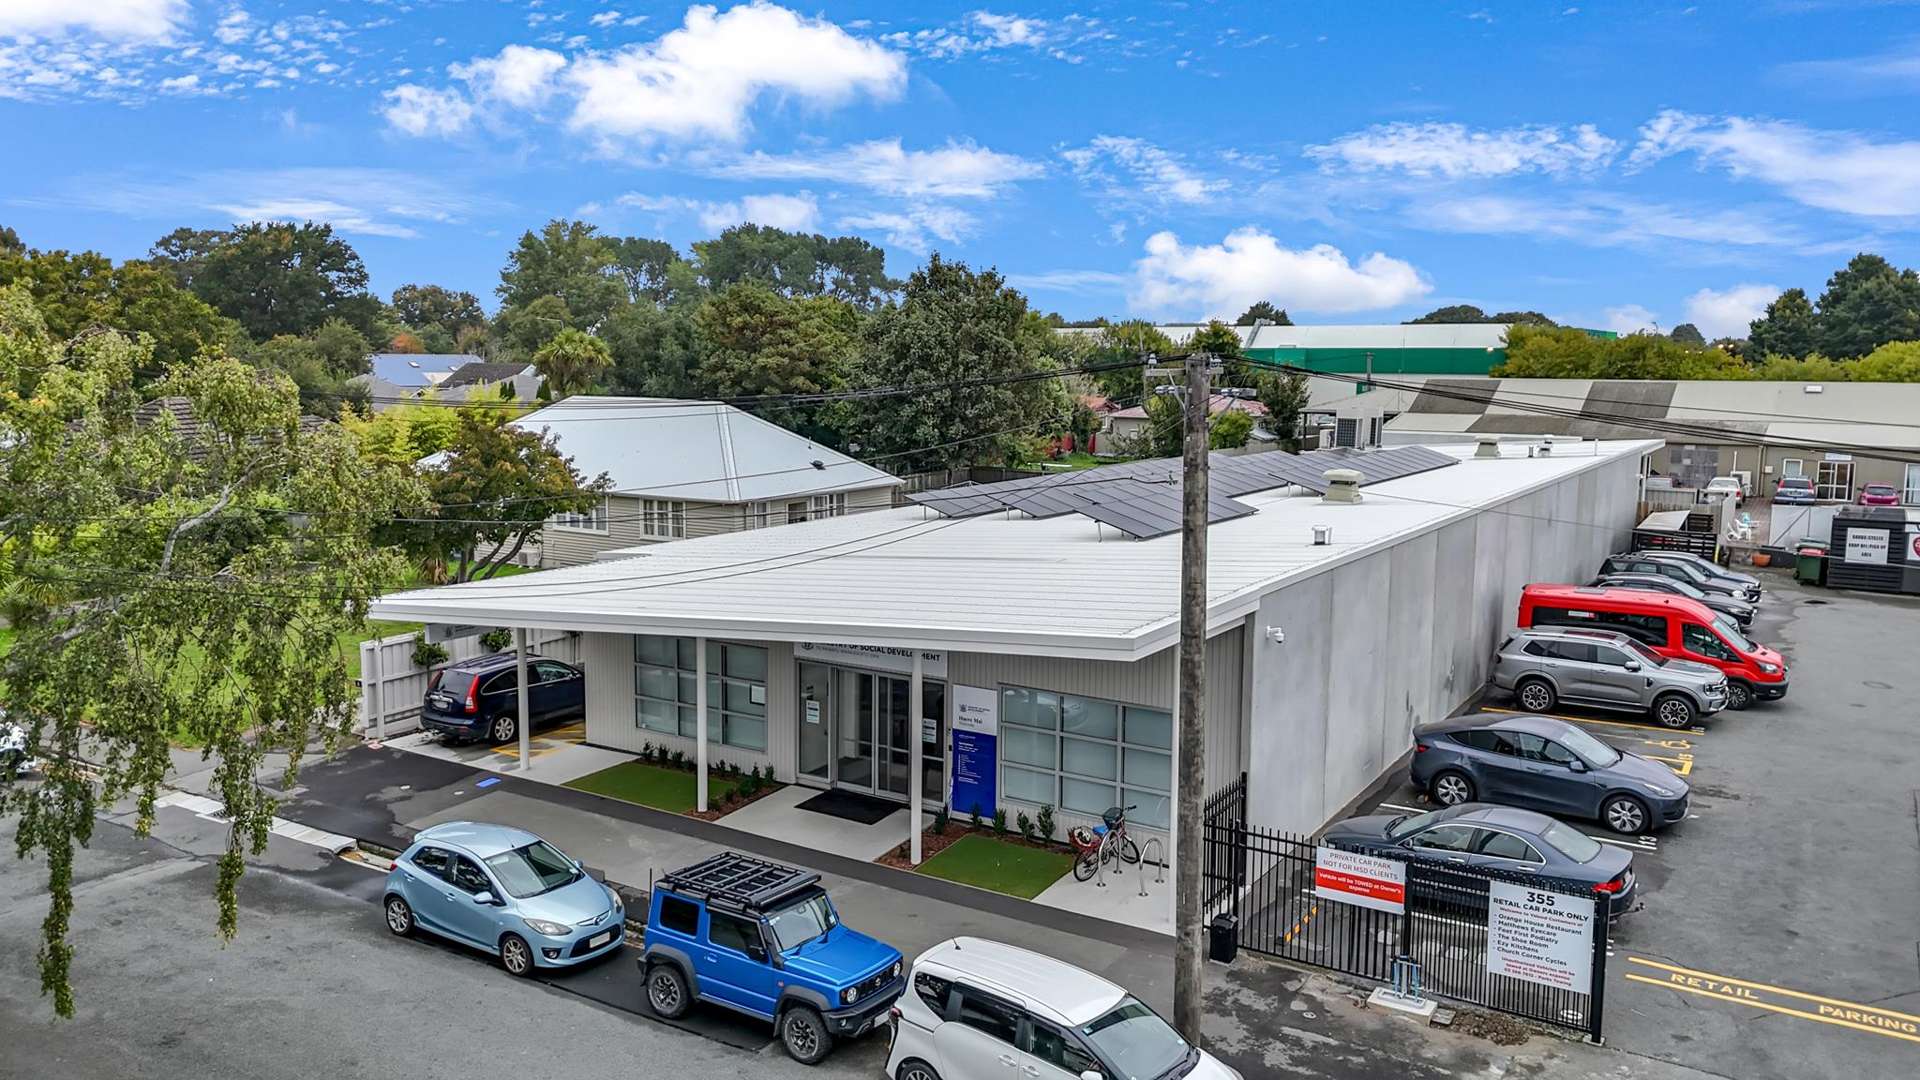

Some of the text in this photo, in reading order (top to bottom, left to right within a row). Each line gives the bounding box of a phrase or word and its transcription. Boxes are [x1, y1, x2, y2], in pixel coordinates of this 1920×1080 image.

[860, 644, 885, 654] SOCIAL
[1330, 852, 1356, 862] PRIVATE
[1374, 861, 1392, 869] PARK
[1320, 872, 1337, 880] Vehicle
[1355, 879, 1373, 888] TOWED
[1370, 869, 1399, 880] CLIENTS
[1527, 891, 1555, 906] 355
[1493, 897, 1589, 922] RETAIL CAR PARK ONLY
[1498, 914, 1582, 935] Orange House Restaurant
[1498, 921, 1556, 936] Matthews Eyecare
[1514, 930, 1528, 938] First
[1530, 934, 1558, 944] Podiatry
[1529, 940, 1548, 948] Room
[1511, 943, 1538, 953] Kitchens
[1497, 946, 1567, 966] Church Corner Cycles
[1670, 972, 1917, 1033] RETAIL PARKING
